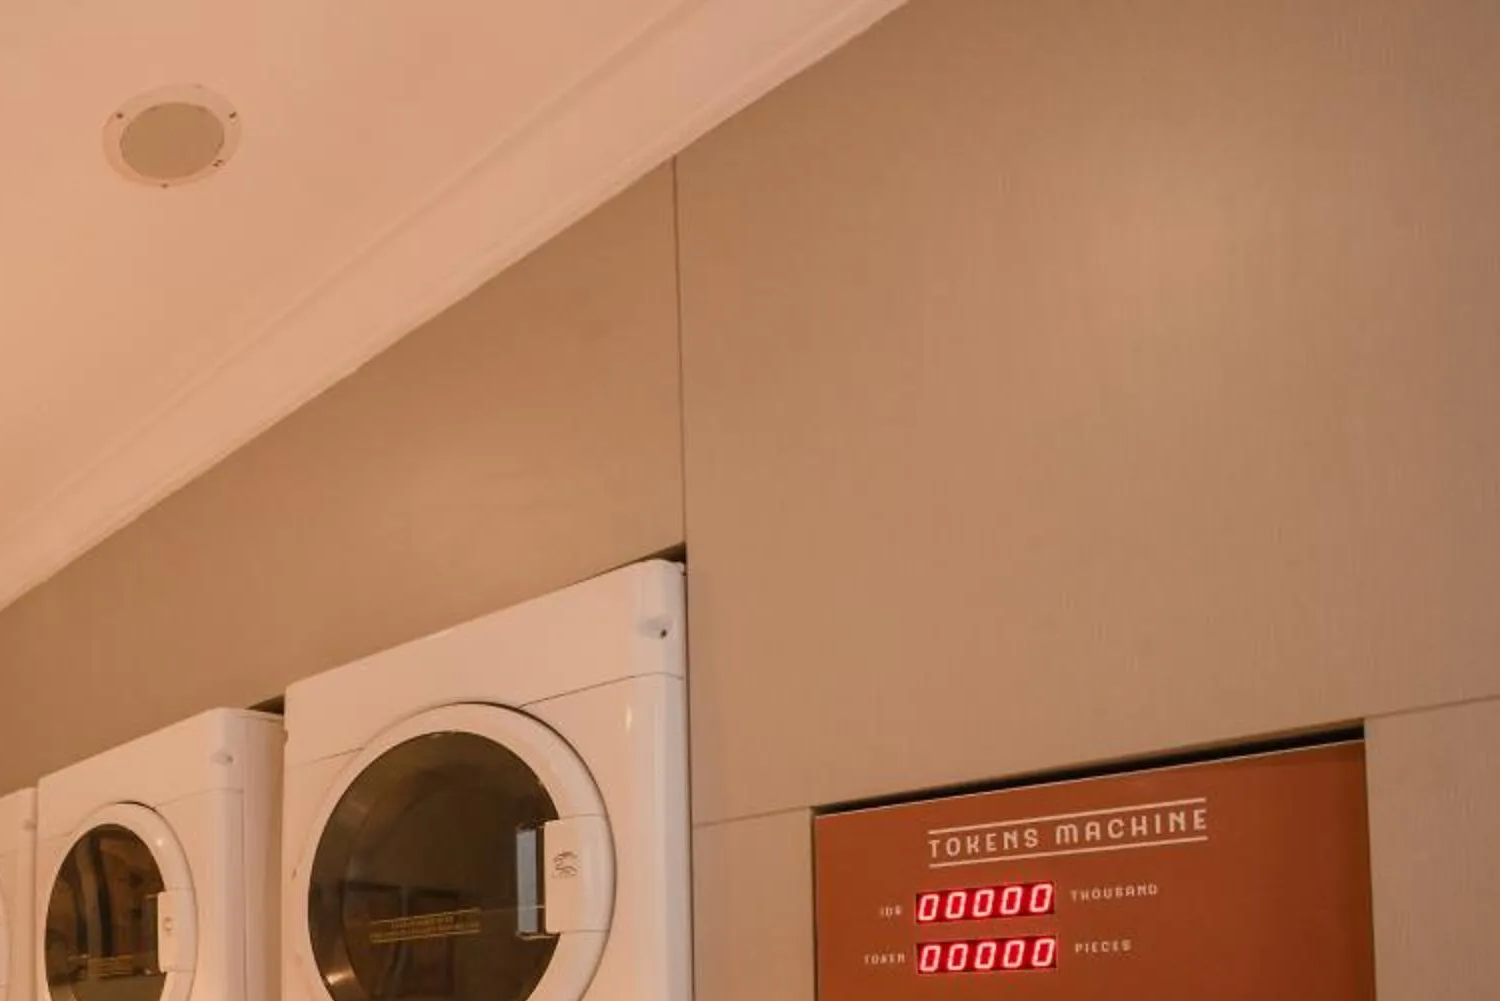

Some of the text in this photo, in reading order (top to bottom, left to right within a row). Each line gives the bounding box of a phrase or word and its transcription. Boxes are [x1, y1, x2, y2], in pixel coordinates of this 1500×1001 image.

[928, 808, 1208, 859] TOKENS MACHINE
[1070, 883, 1159, 902] THOUSAND
[879, 905, 903, 918] IDR
[917, 882, 1054, 923] 00000
[919, 937, 1057, 973] 00000
[1074, 939, 1132, 954] PIECES
[863, 953, 906, 966] TOKEN
